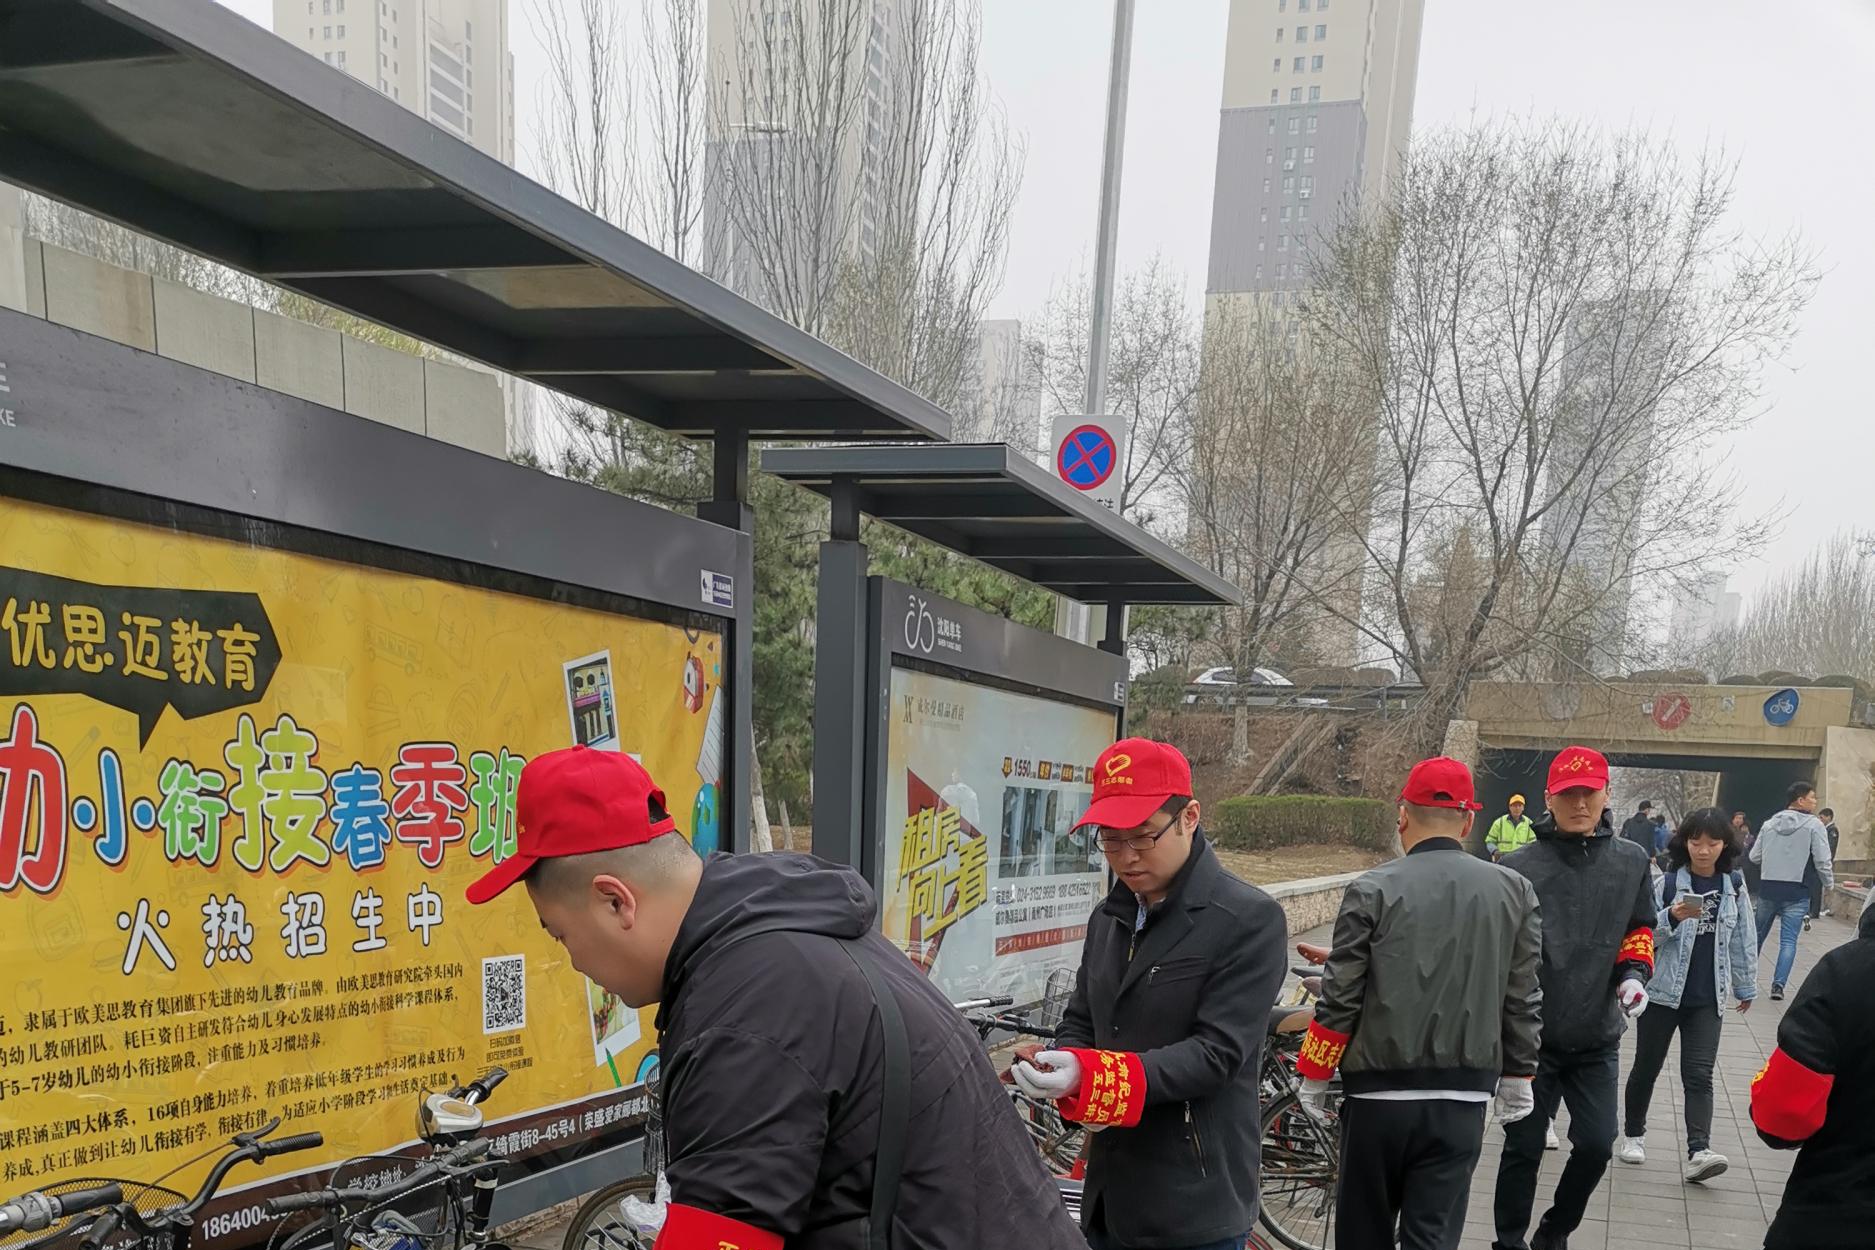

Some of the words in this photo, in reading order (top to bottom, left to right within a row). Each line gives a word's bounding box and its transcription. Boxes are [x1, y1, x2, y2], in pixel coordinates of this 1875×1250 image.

[2, 598, 261, 691] 优思迈教育
[896, 806, 963, 893] 租房
[904, 835, 988, 951] 向上看
[117, 882, 444, 976] 火热招生中
[1083, 1070, 1103, 1123] 五三街
[202, 1203, 288, 1241] 1864004
